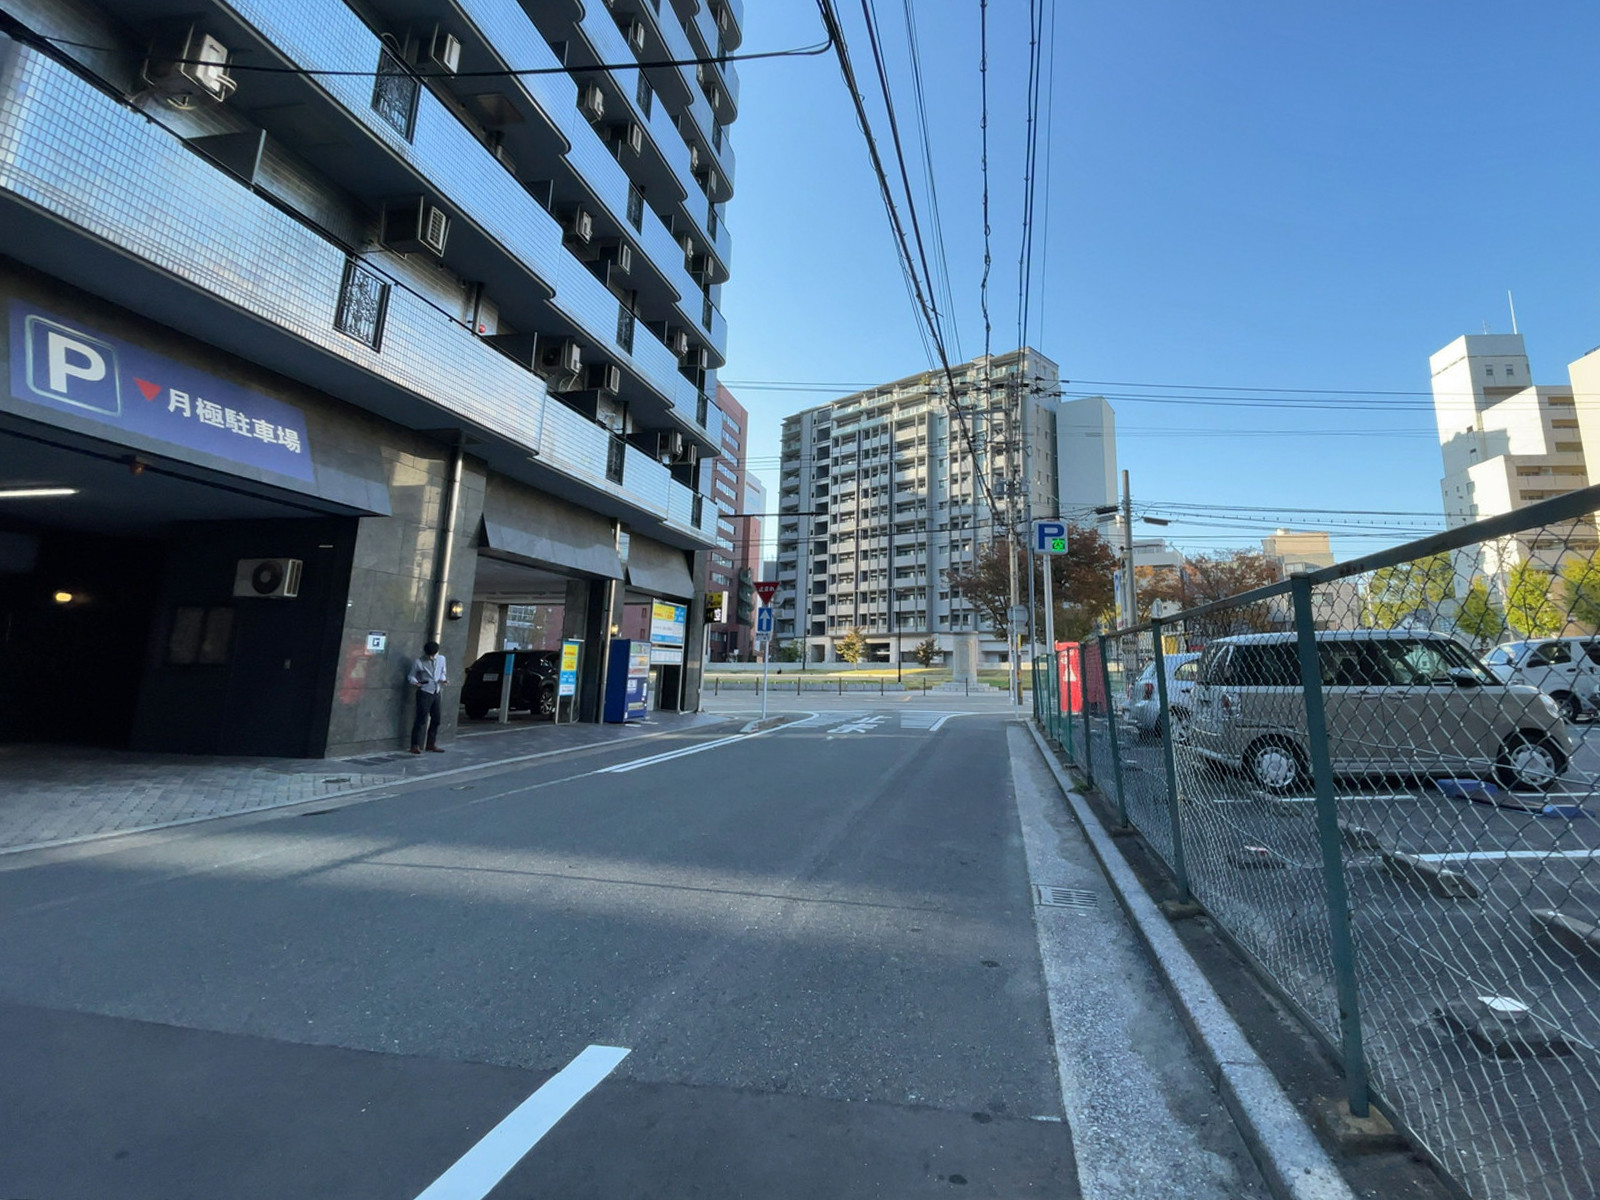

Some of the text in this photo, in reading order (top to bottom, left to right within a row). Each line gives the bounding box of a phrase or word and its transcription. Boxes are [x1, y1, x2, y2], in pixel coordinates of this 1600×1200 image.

[48, 332, 106, 394] P
[167, 388, 302, 454] 月極駐車場
[1038, 523, 1064, 550] P
